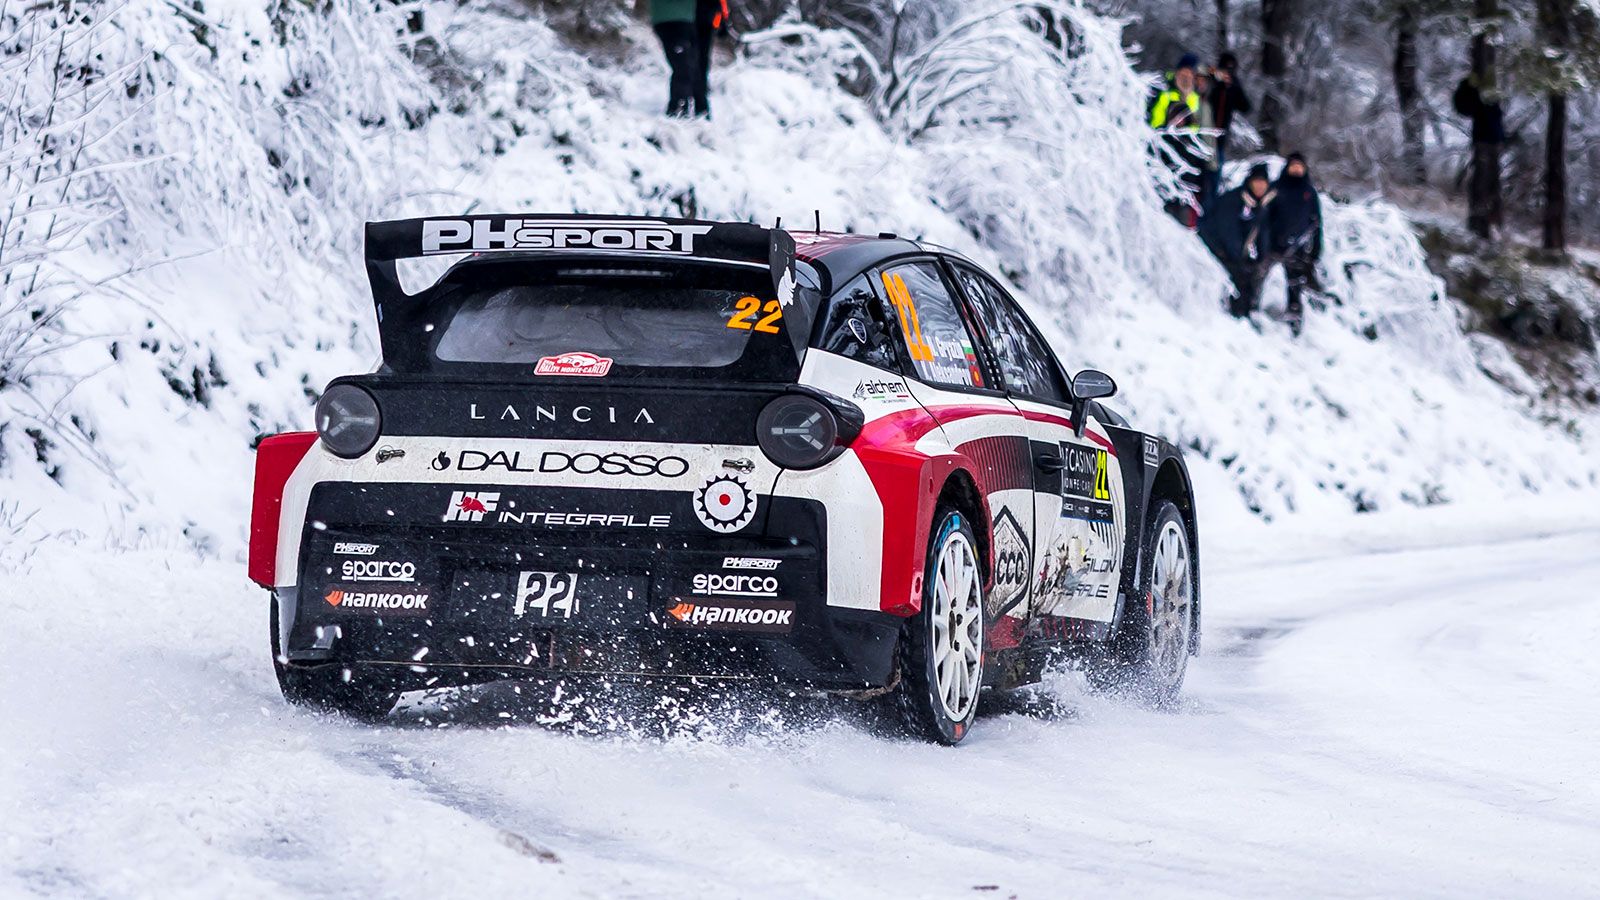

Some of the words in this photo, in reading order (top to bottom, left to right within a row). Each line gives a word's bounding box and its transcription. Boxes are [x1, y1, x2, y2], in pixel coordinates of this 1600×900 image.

[726, 296, 783, 334] 22
[881, 271, 934, 362] 22
[865, 379, 906, 394] alchem
[470, 403, 655, 424] LANCIA
[1069, 448, 1097, 475] CASINO
[1095, 450, 1110, 500] 22
[446, 491, 500, 521] HF
[498, 511, 671, 528] INTEGRALE
[341, 560, 417, 581] sparco
[692, 574, 778, 597] sparco
[524, 572, 571, 618] 22
